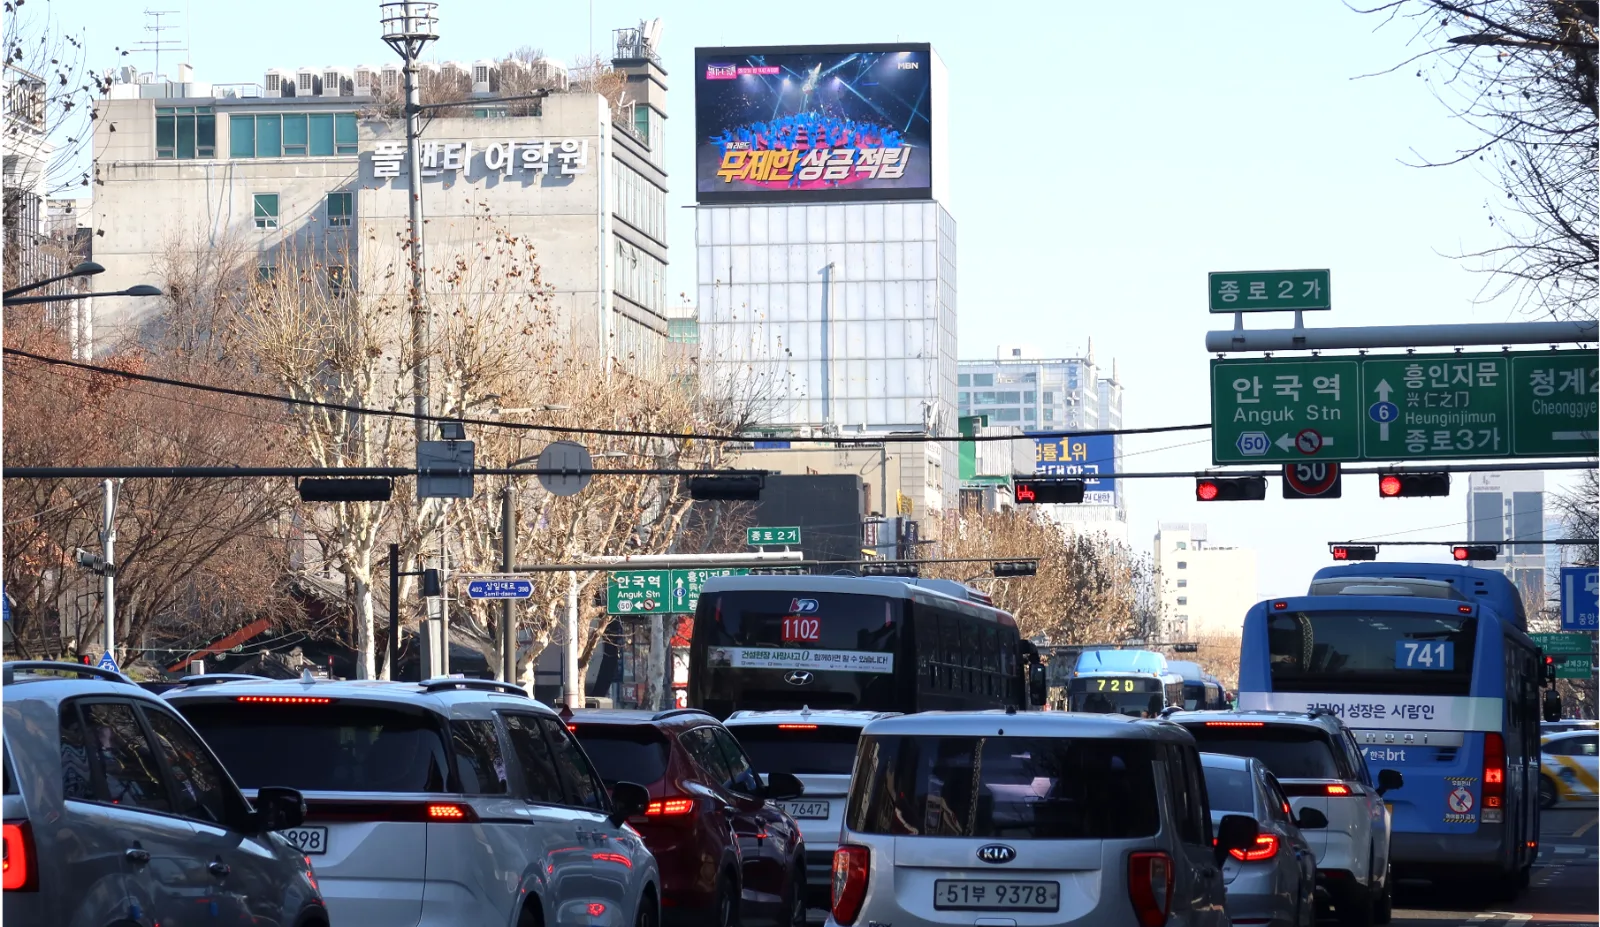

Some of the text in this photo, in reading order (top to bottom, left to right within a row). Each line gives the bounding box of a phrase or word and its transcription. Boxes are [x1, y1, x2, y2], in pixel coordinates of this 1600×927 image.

[897, 62, 918, 70] MBN
[485, 139, 589, 176] 어학원
[717, 147, 912, 183] 무제한 상금 적립
[1403, 362, 1499, 389] 흥인지문
[1406, 391, 1470, 408] 兴仁之门
[1233, 404, 1341, 425] Anguk Stn
[1379, 405, 1390, 420] 6
[1405, 411, 1496, 427] Heunginjimun
[1243, 436, 1264, 451] 50
[1405, 427, 1500, 453] 종로3가
[1297, 463, 1326, 481] 50
[617, 590, 660, 599] Anguk Stn
[1579, 612, 1599, 626] 중앙
[783, 618, 819, 640] 1102
[1404, 643, 1446, 668] 741
[1097, 680, 1134, 692] 720
[1347, 704, 1387, 719] 성장은
[1391, 704, 1435, 720] 사람인
[791, 803, 822, 815] 7647
[281, 830, 320, 849] 898
[984, 848, 1009, 859] KIA
[947, 884, 1047, 905] 51부 9378
